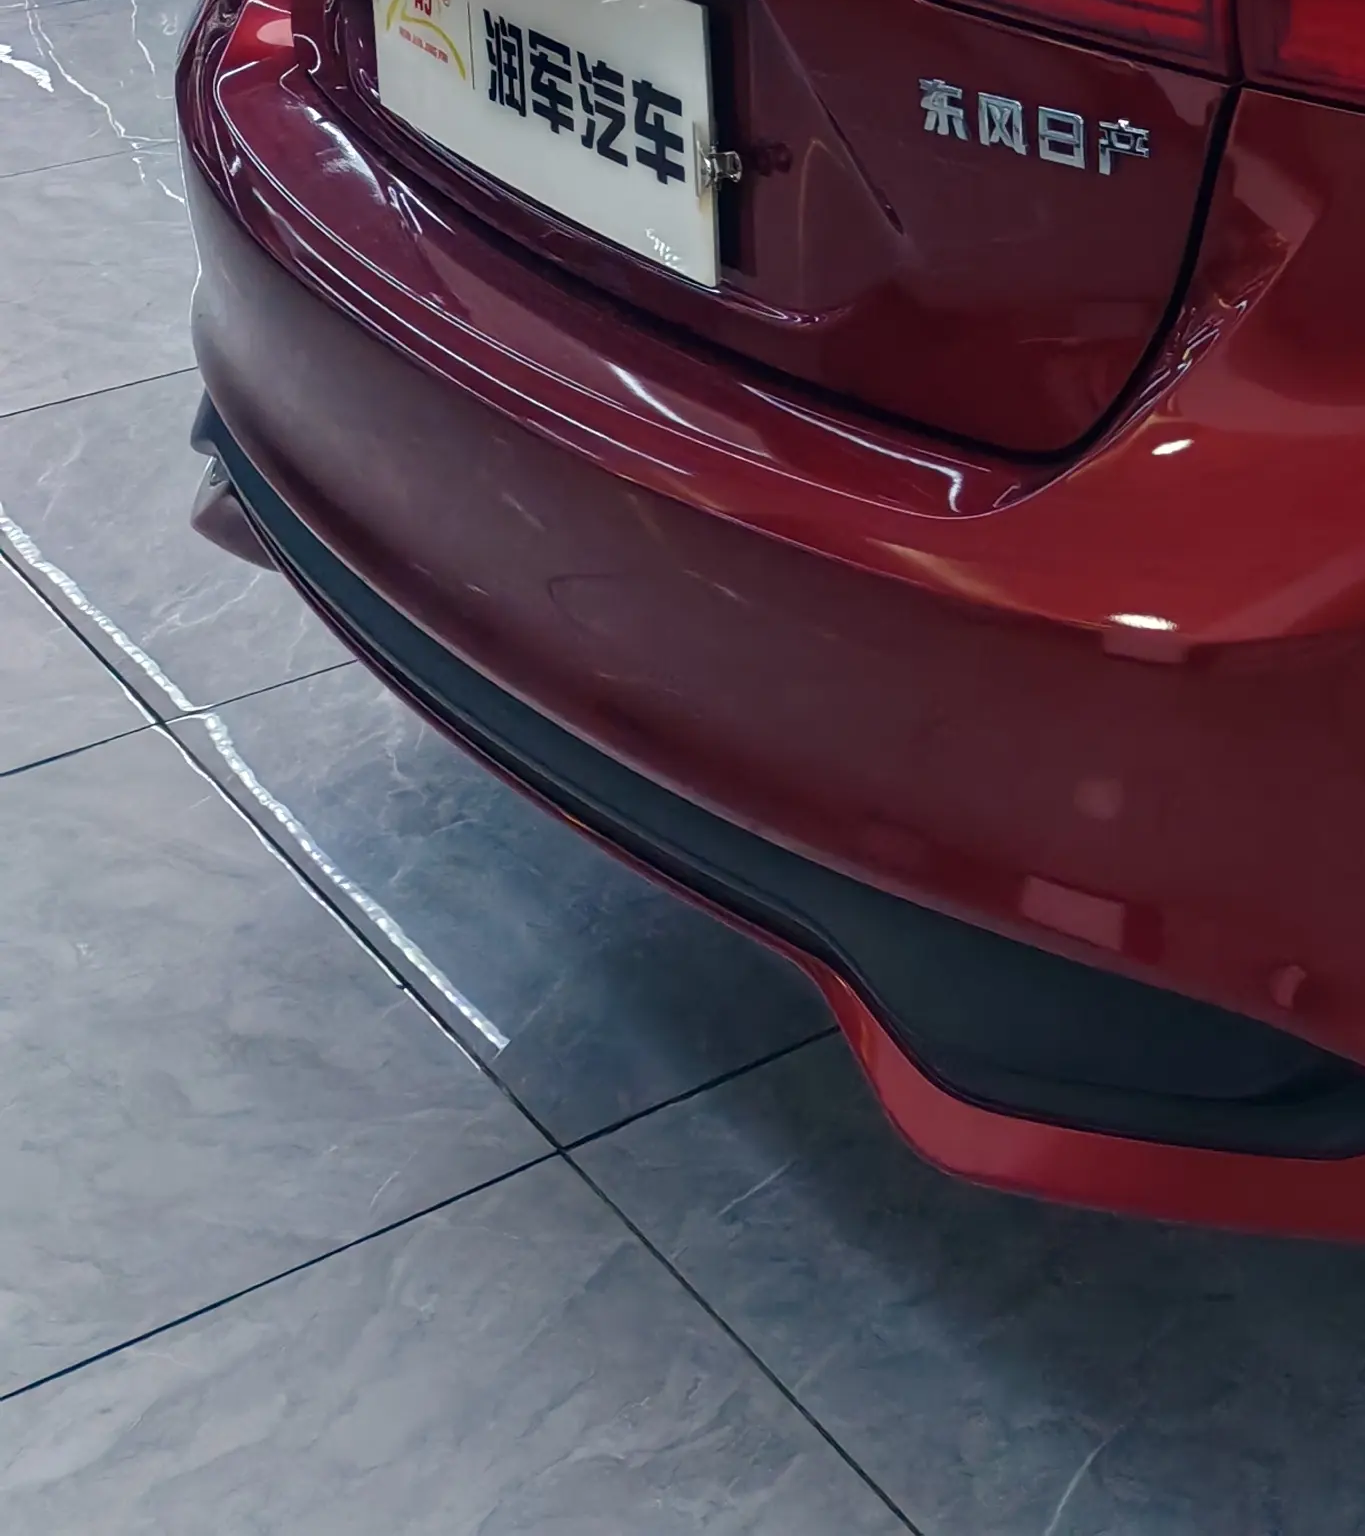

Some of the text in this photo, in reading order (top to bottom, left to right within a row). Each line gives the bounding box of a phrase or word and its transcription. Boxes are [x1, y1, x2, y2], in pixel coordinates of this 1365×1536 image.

[483, 8, 686, 185] 润军汽车
[918, 78, 1150, 176] 东风日产
